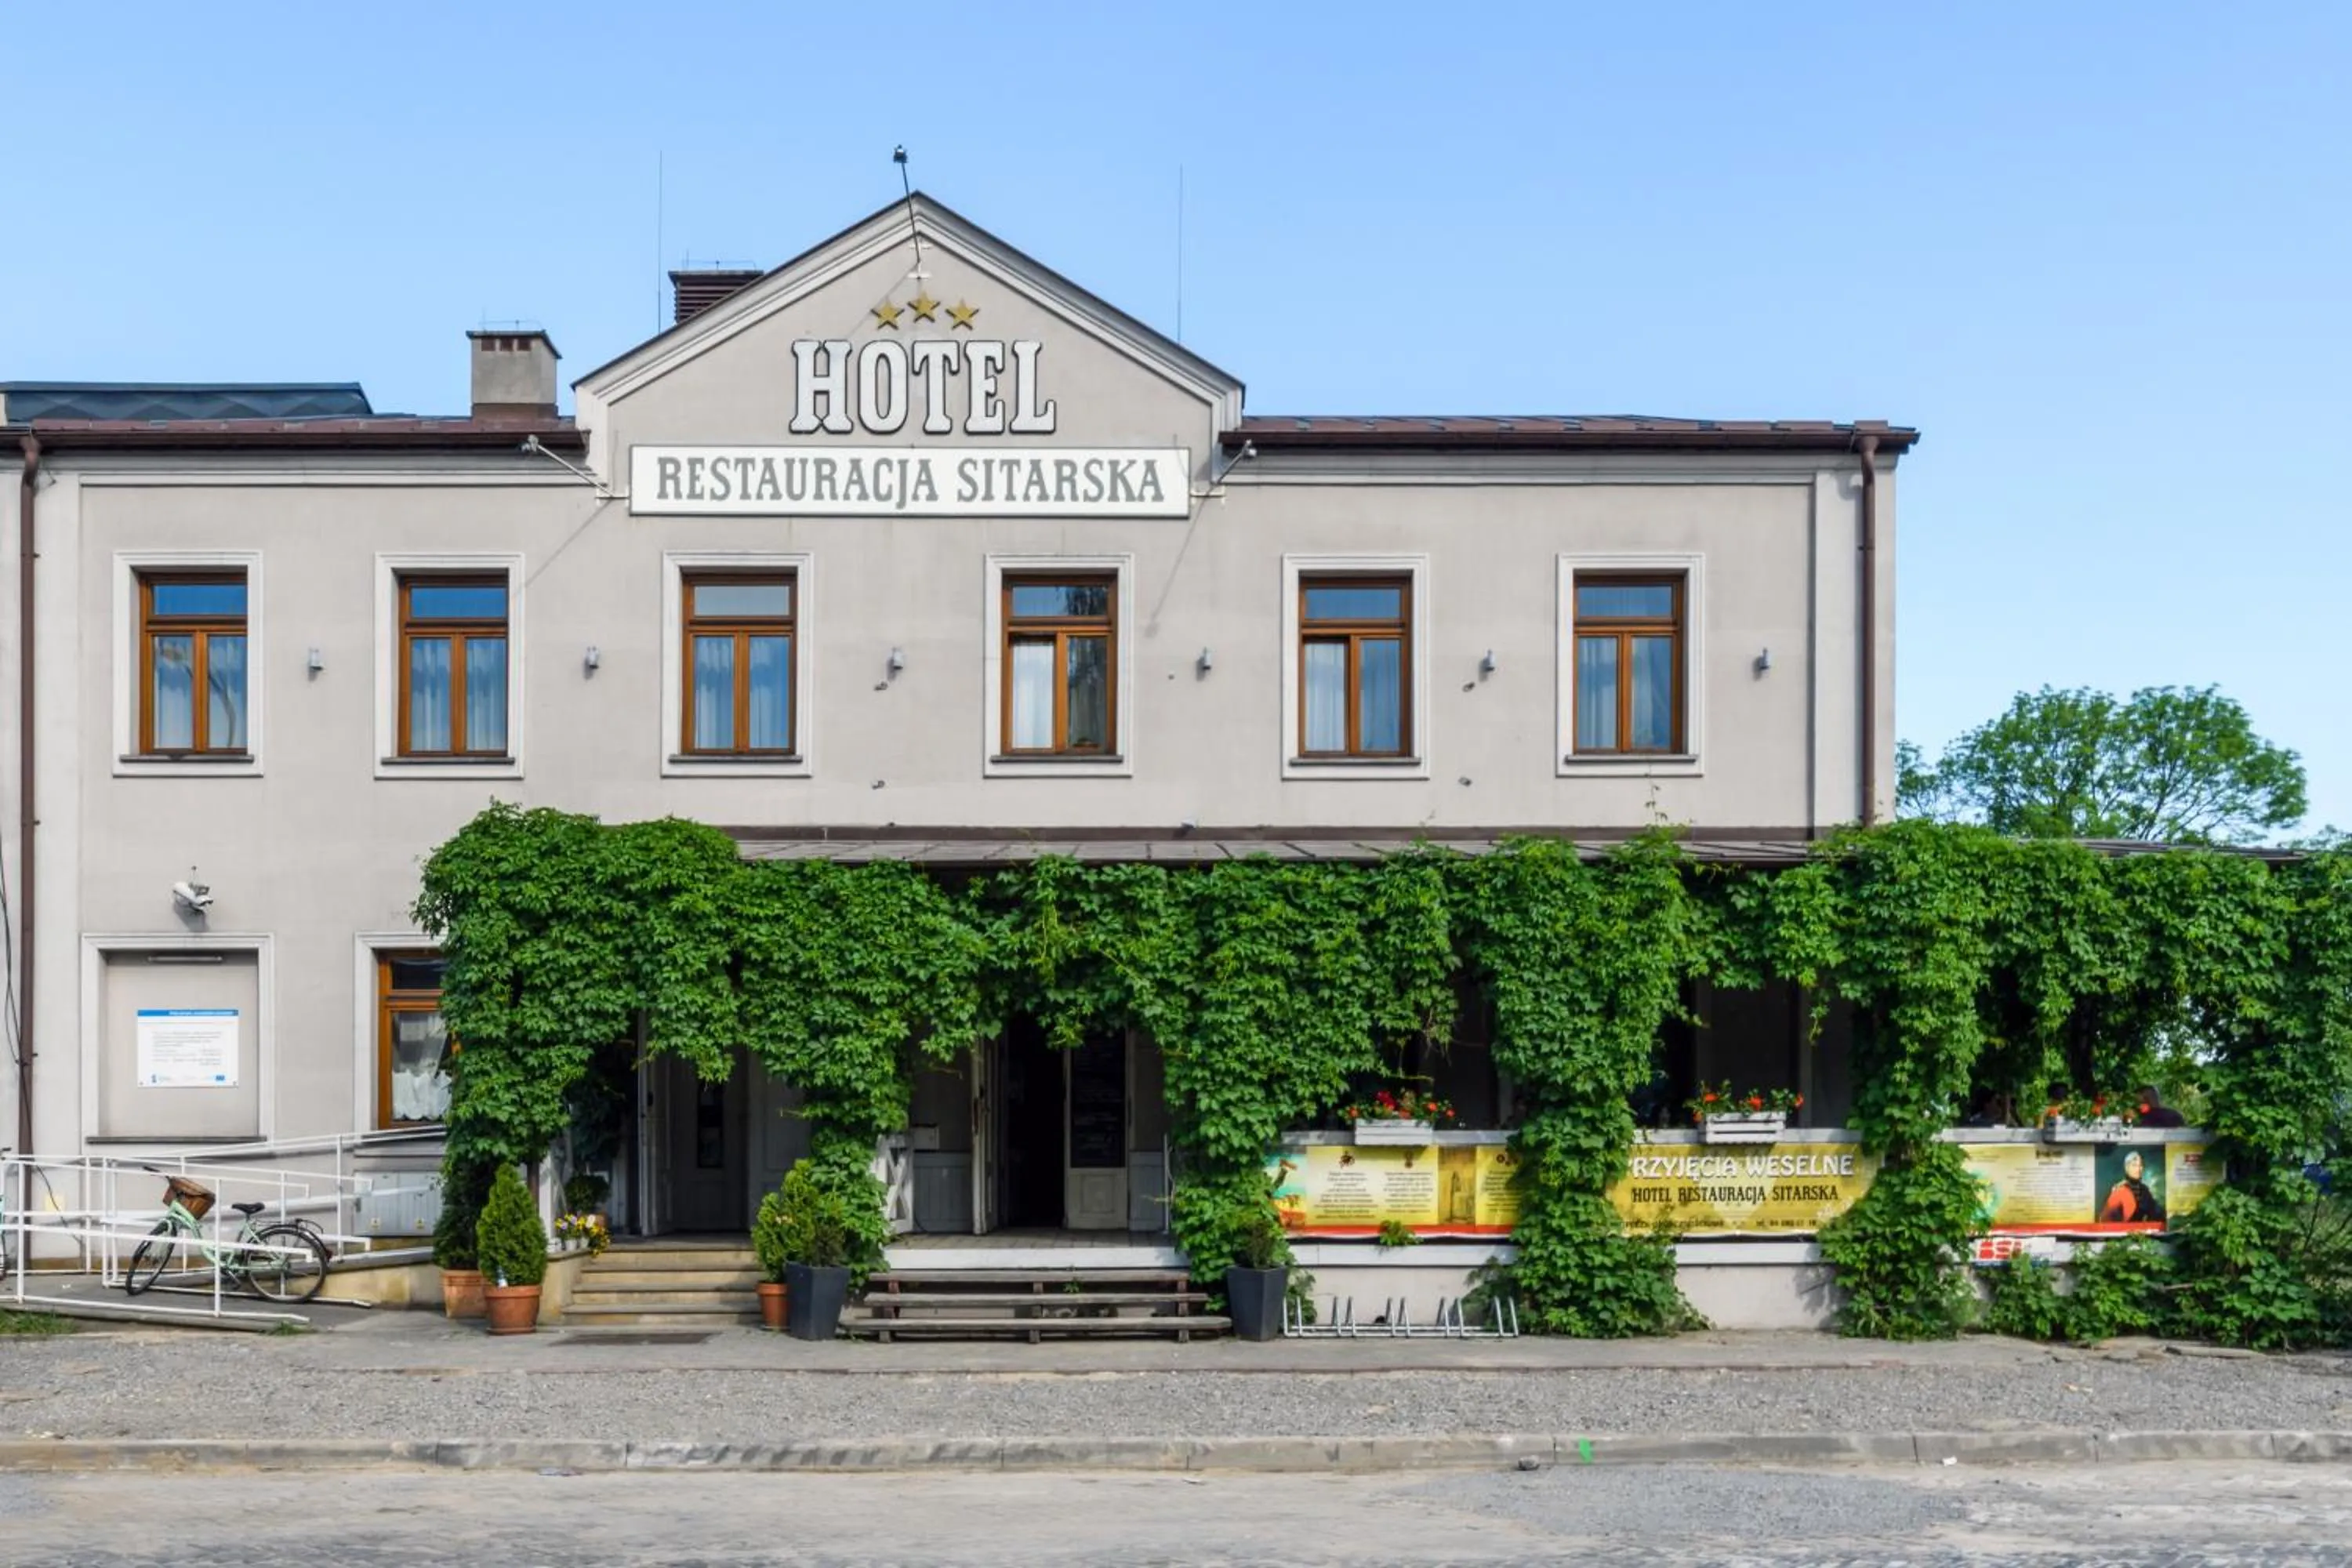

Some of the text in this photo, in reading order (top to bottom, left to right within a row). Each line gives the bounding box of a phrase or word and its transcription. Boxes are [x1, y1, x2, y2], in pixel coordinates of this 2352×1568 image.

[789, 339, 1056, 434] HOTEL
[656, 456, 1164, 510] RESTAURACJA SITARSKA
[1628, 1154, 1854, 1181] RZYJĘCIA WESELNE
[1632, 1185, 1838, 1204] HOTEL RESTAURACJA SITARSKA
